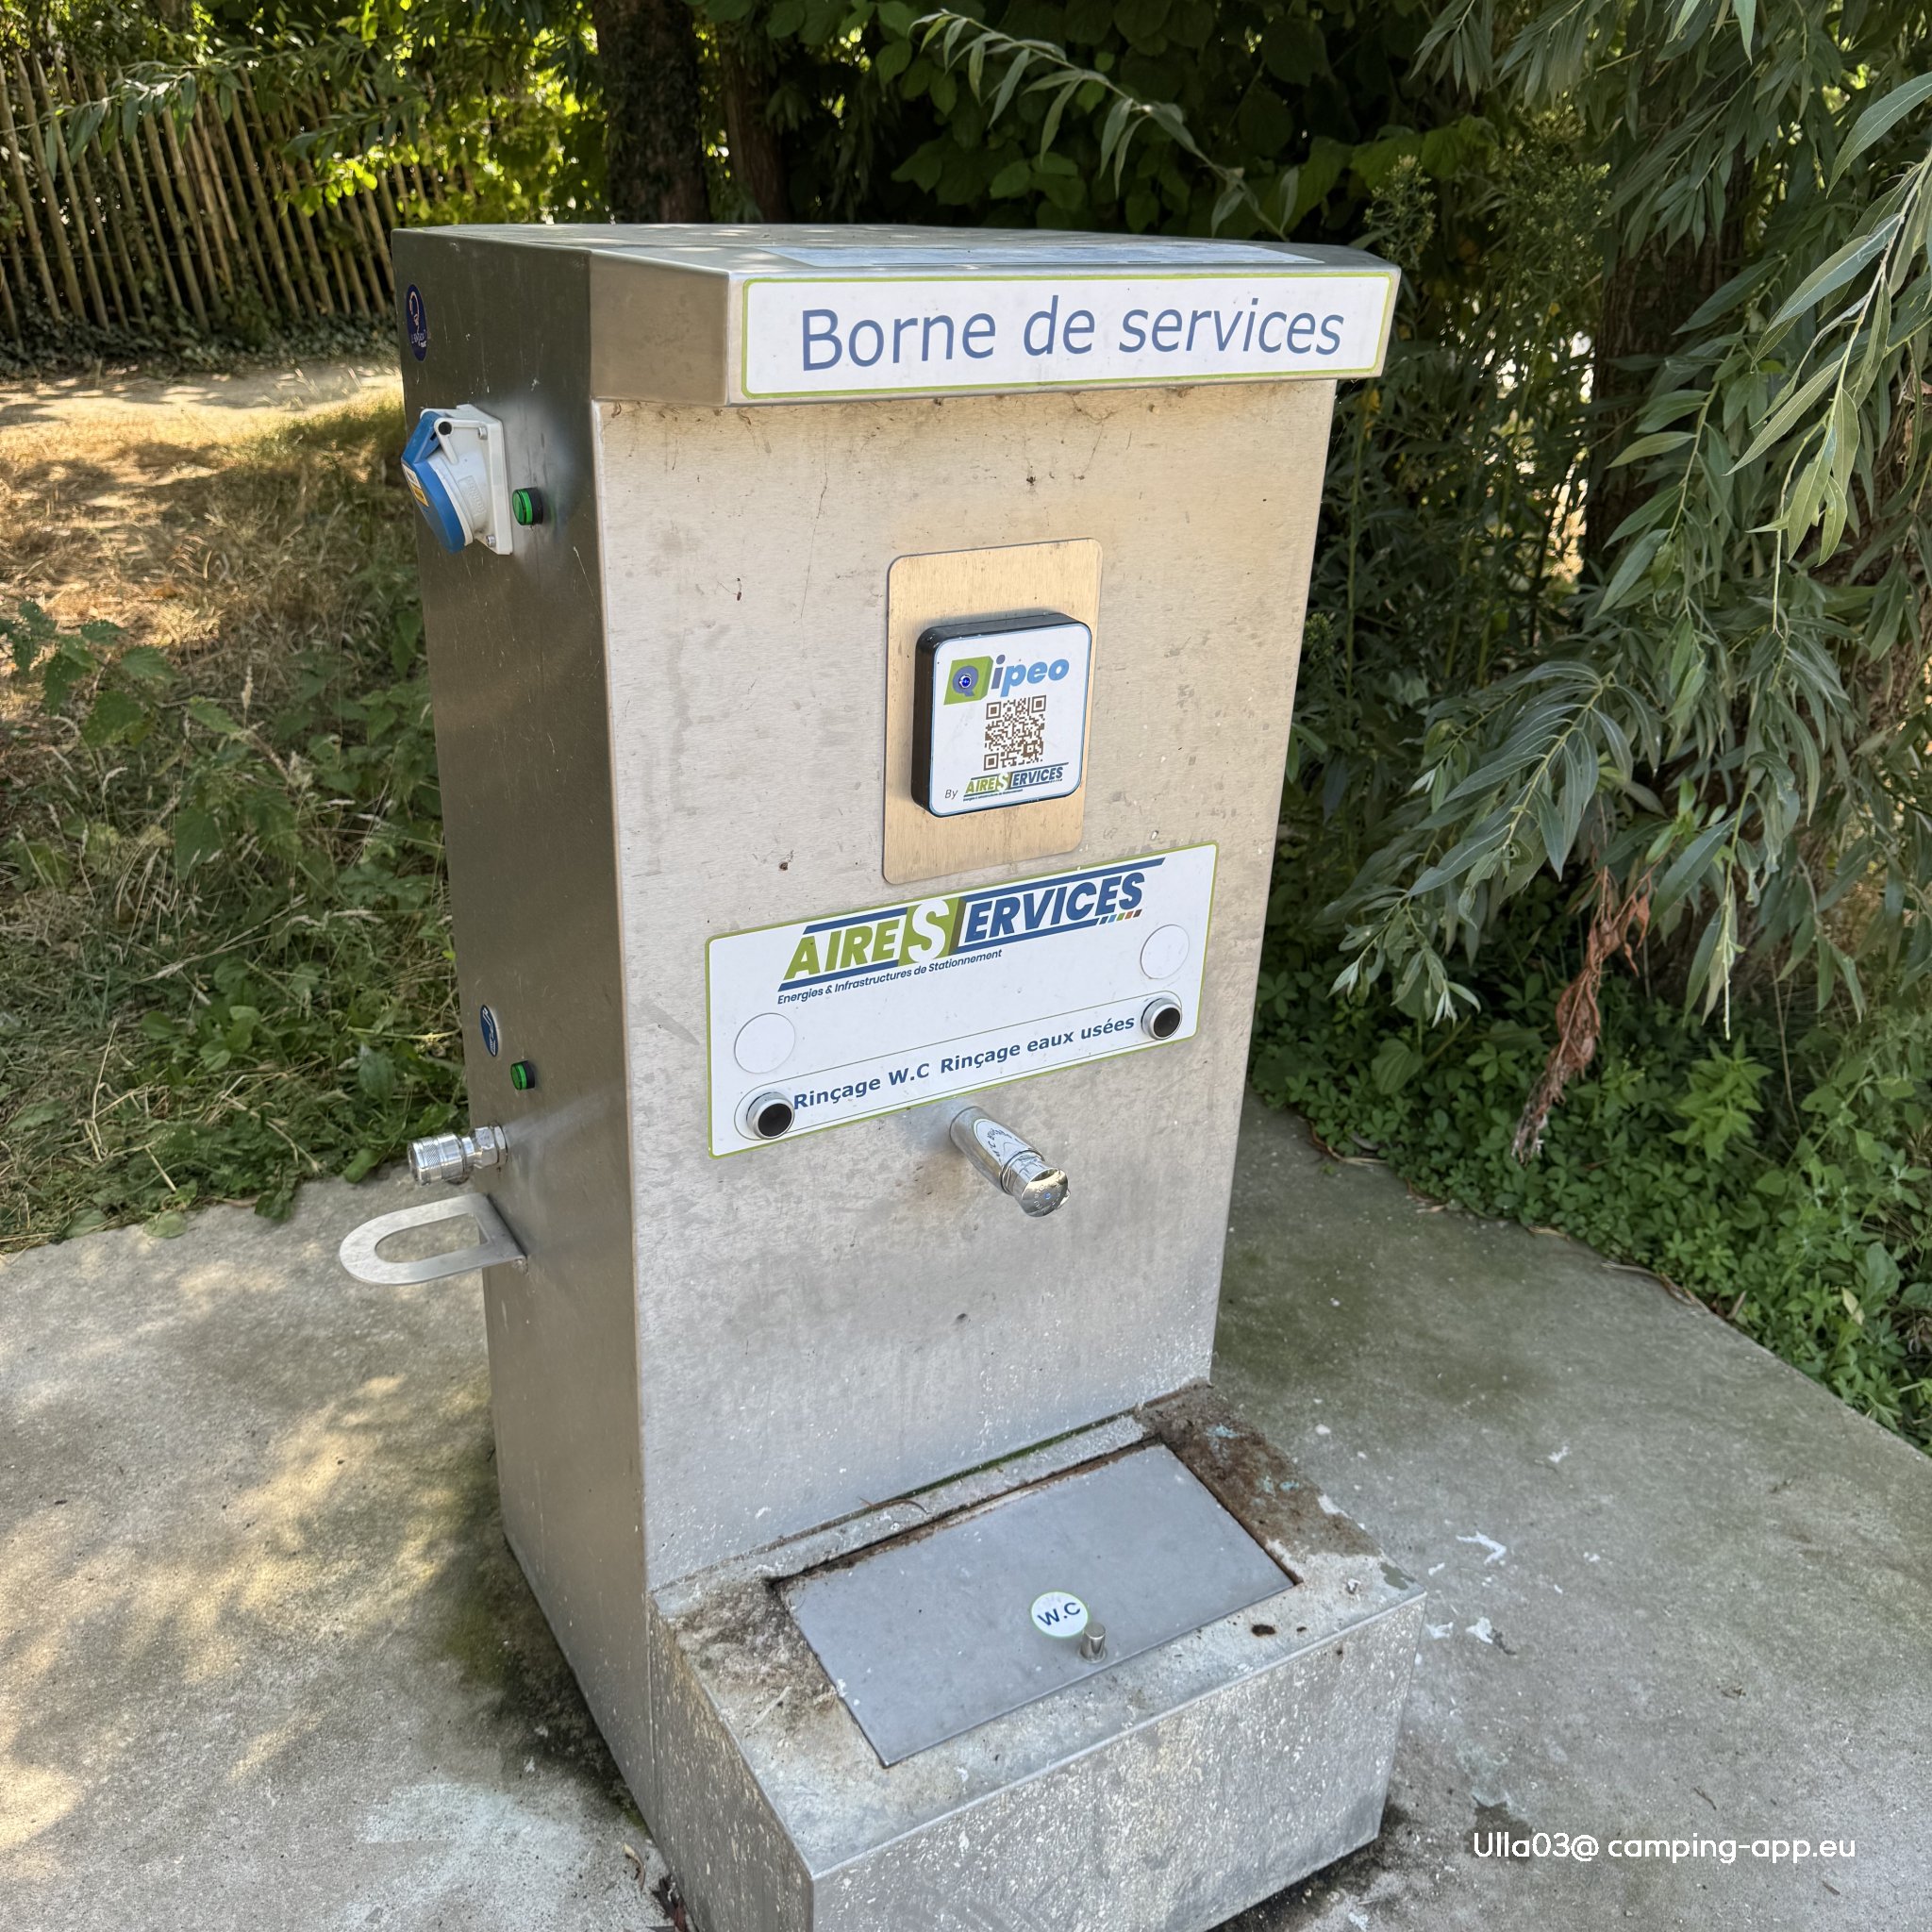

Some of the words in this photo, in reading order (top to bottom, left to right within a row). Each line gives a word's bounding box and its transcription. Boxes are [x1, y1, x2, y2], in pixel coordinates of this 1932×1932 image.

[800, 308, 996, 372] Borne
[1024, 295, 1096, 357] de
[1118, 297, 1345, 357] services
[944, 789, 958, 800] By
[777, 988, 824, 1005] Energies
[824, 985, 833, 994] &
[834, 969, 912, 992] Infrastructures
[913, 964, 927, 975] de
[928, 949, 1003, 973] Stationnement
[941, 1041, 1021, 1074] Rinçage
[1026, 1031, 1074, 1053] eaux
[1080, 1016, 1135, 1040] usées
[793, 1076, 881, 1109] Rinçage
[889, 1062, 929, 1087] W.C
[1037, 1602, 1080, 1626] W.C
